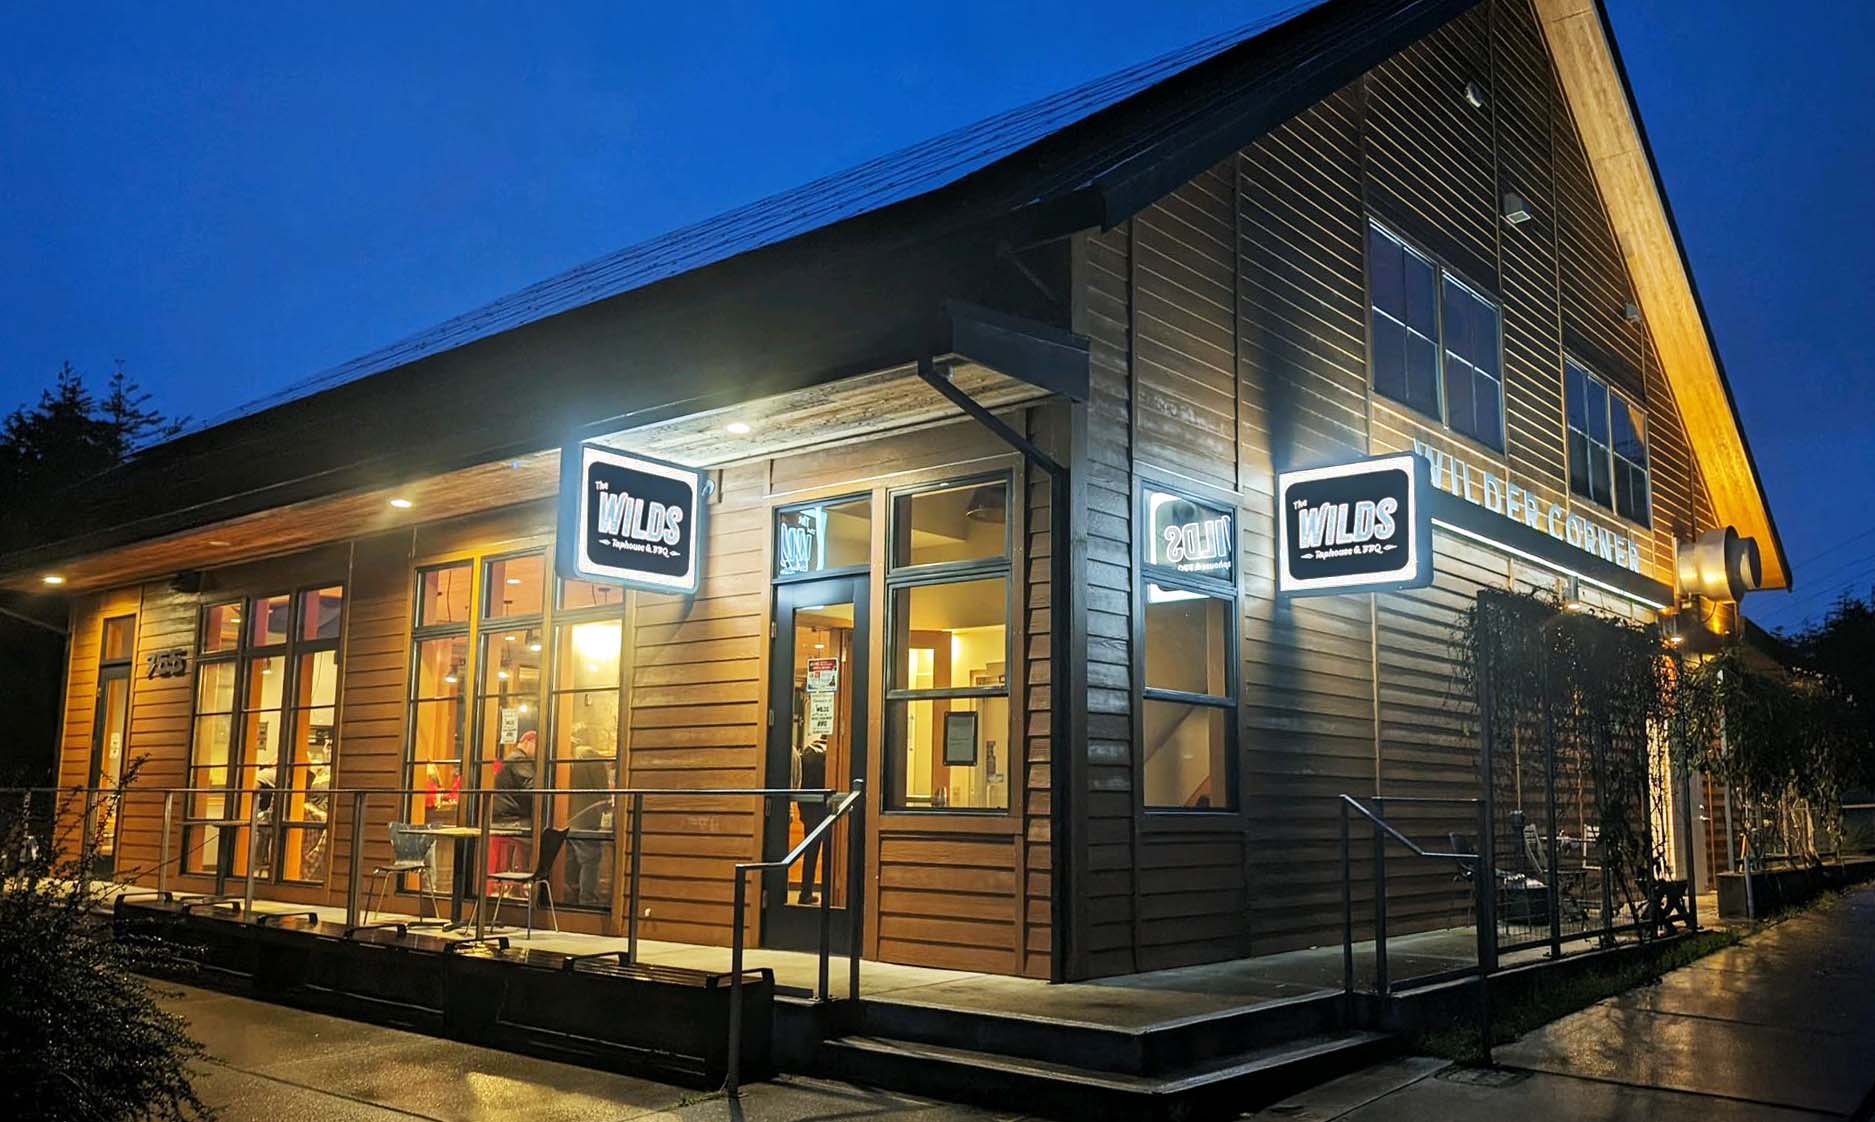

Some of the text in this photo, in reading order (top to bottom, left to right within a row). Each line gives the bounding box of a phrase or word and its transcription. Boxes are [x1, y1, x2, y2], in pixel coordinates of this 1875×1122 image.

[594, 480, 609, 491] The
[1293, 499, 1308, 510] The
[1413, 438, 1641, 574] WILDER CORNER
[598, 491, 684, 546] WILDS
[1298, 497, 1399, 549] WILDS
